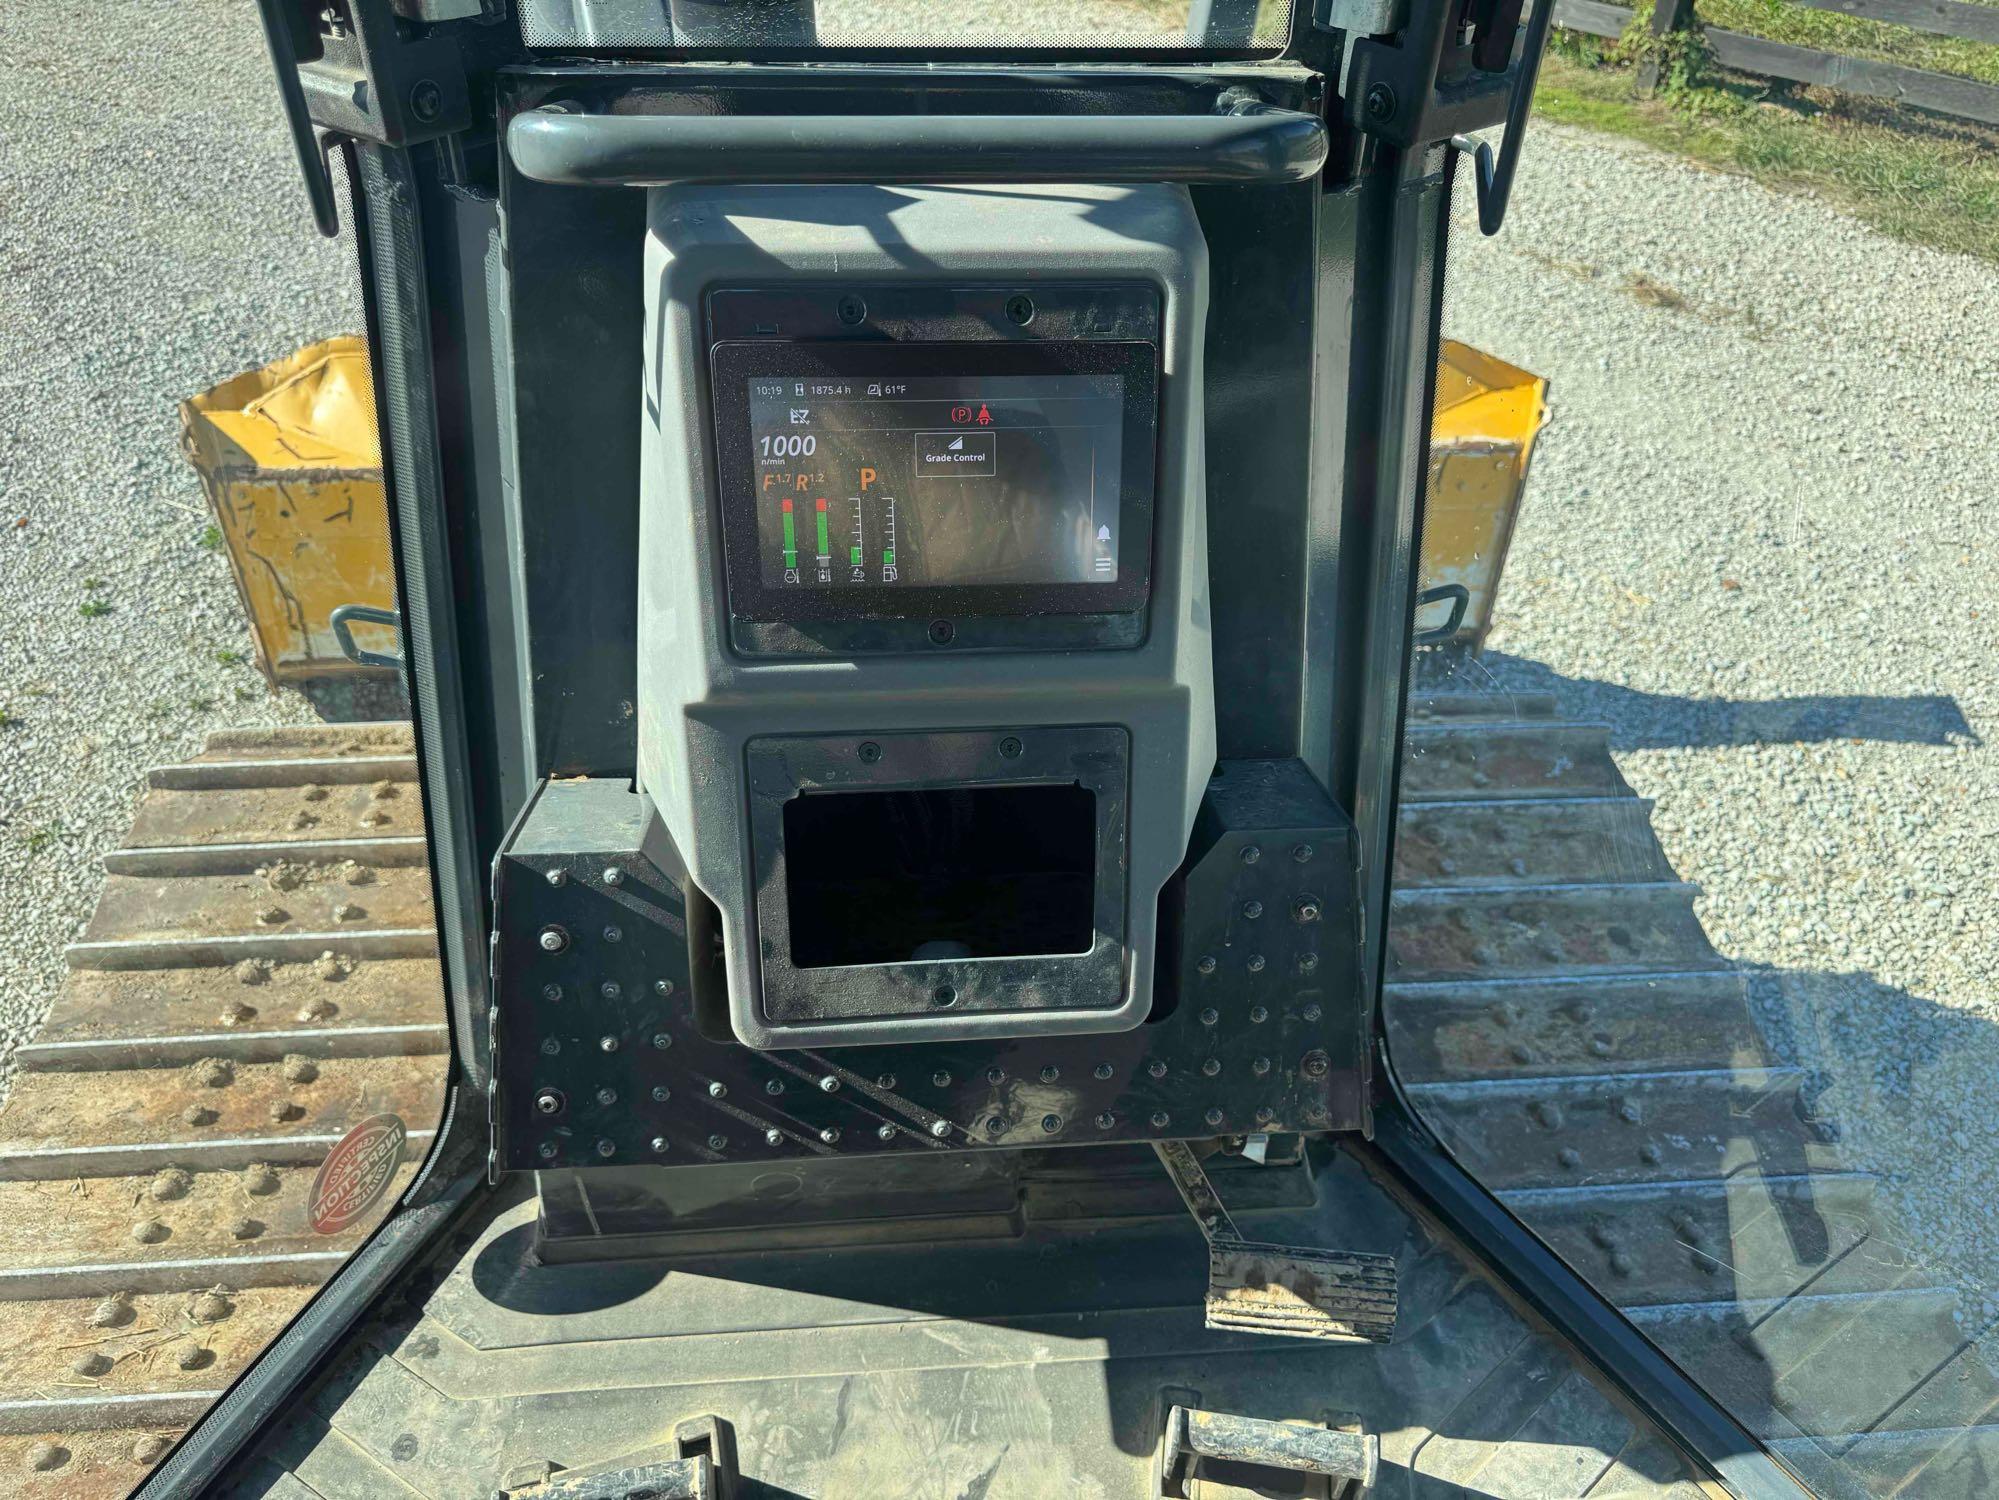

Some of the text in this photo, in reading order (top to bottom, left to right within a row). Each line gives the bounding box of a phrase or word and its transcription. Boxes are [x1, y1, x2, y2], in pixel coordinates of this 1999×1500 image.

[756, 386, 782, 395] 10:19
[811, 385, 851, 395] 1875.4 h
[885, 385, 907, 394] 61°F
[760, 435, 816, 457] 1000
[761, 457, 785, 466] n/min
[925, 453, 985, 462] Grade Control
[860, 467, 877, 491] P
